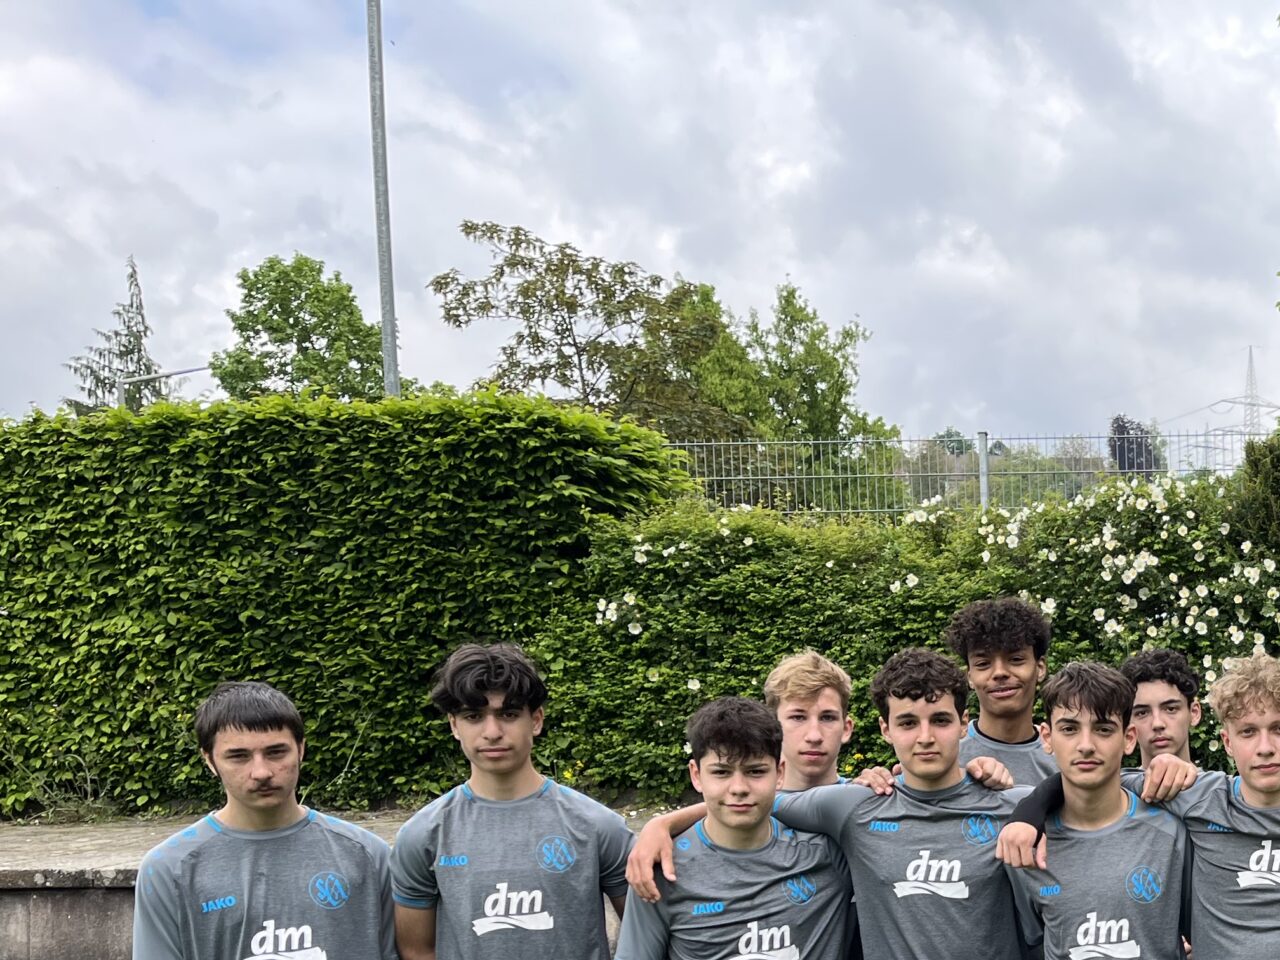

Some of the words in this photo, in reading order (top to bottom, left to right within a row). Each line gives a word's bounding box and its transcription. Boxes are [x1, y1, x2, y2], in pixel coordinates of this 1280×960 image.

[868, 820, 899, 833] JAKO
[438, 854, 469, 868] JAKO
[906, 849, 962, 882] dm
[201, 895, 237, 914] JAKO
[484, 881, 543, 918] dm
[691, 901, 725, 916] JAKO
[251, 919, 313, 956] dm
[738, 920, 792, 955] dm
[1076, 911, 1130, 946] dm
